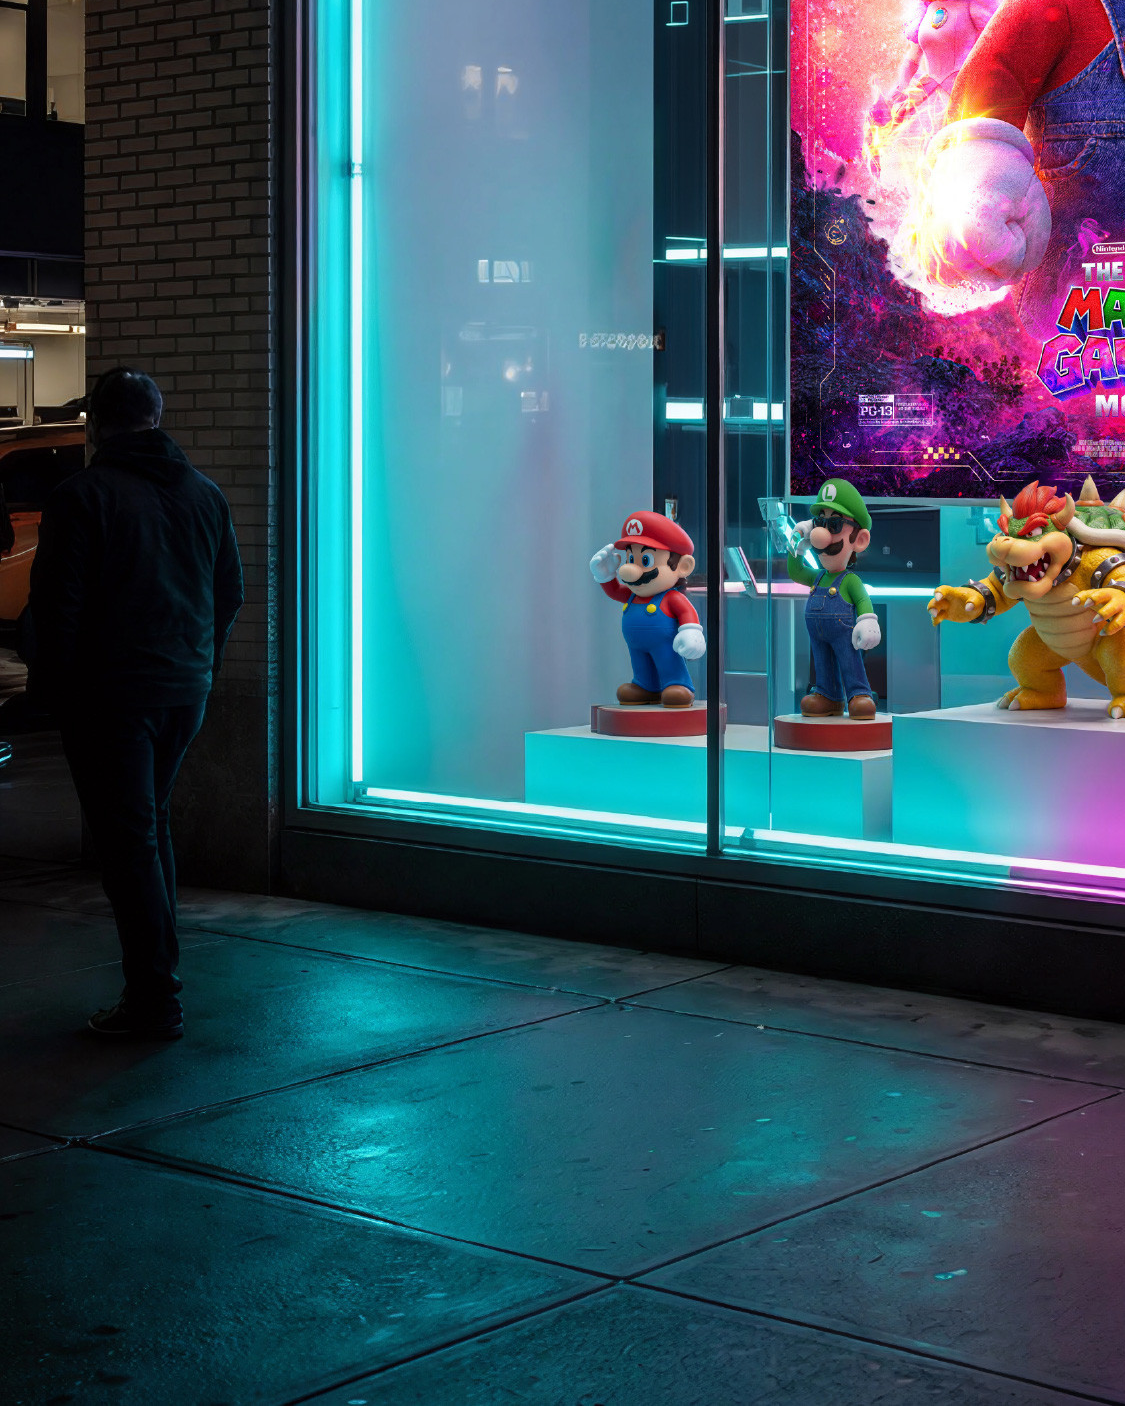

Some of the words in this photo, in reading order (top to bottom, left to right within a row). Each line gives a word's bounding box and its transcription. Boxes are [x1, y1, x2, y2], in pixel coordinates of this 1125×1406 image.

[1081, 261, 1124, 282] THE
[860, 405, 893, 417] PG-13
[825, 486, 833, 500] L
[627, 522, 641, 534] M
